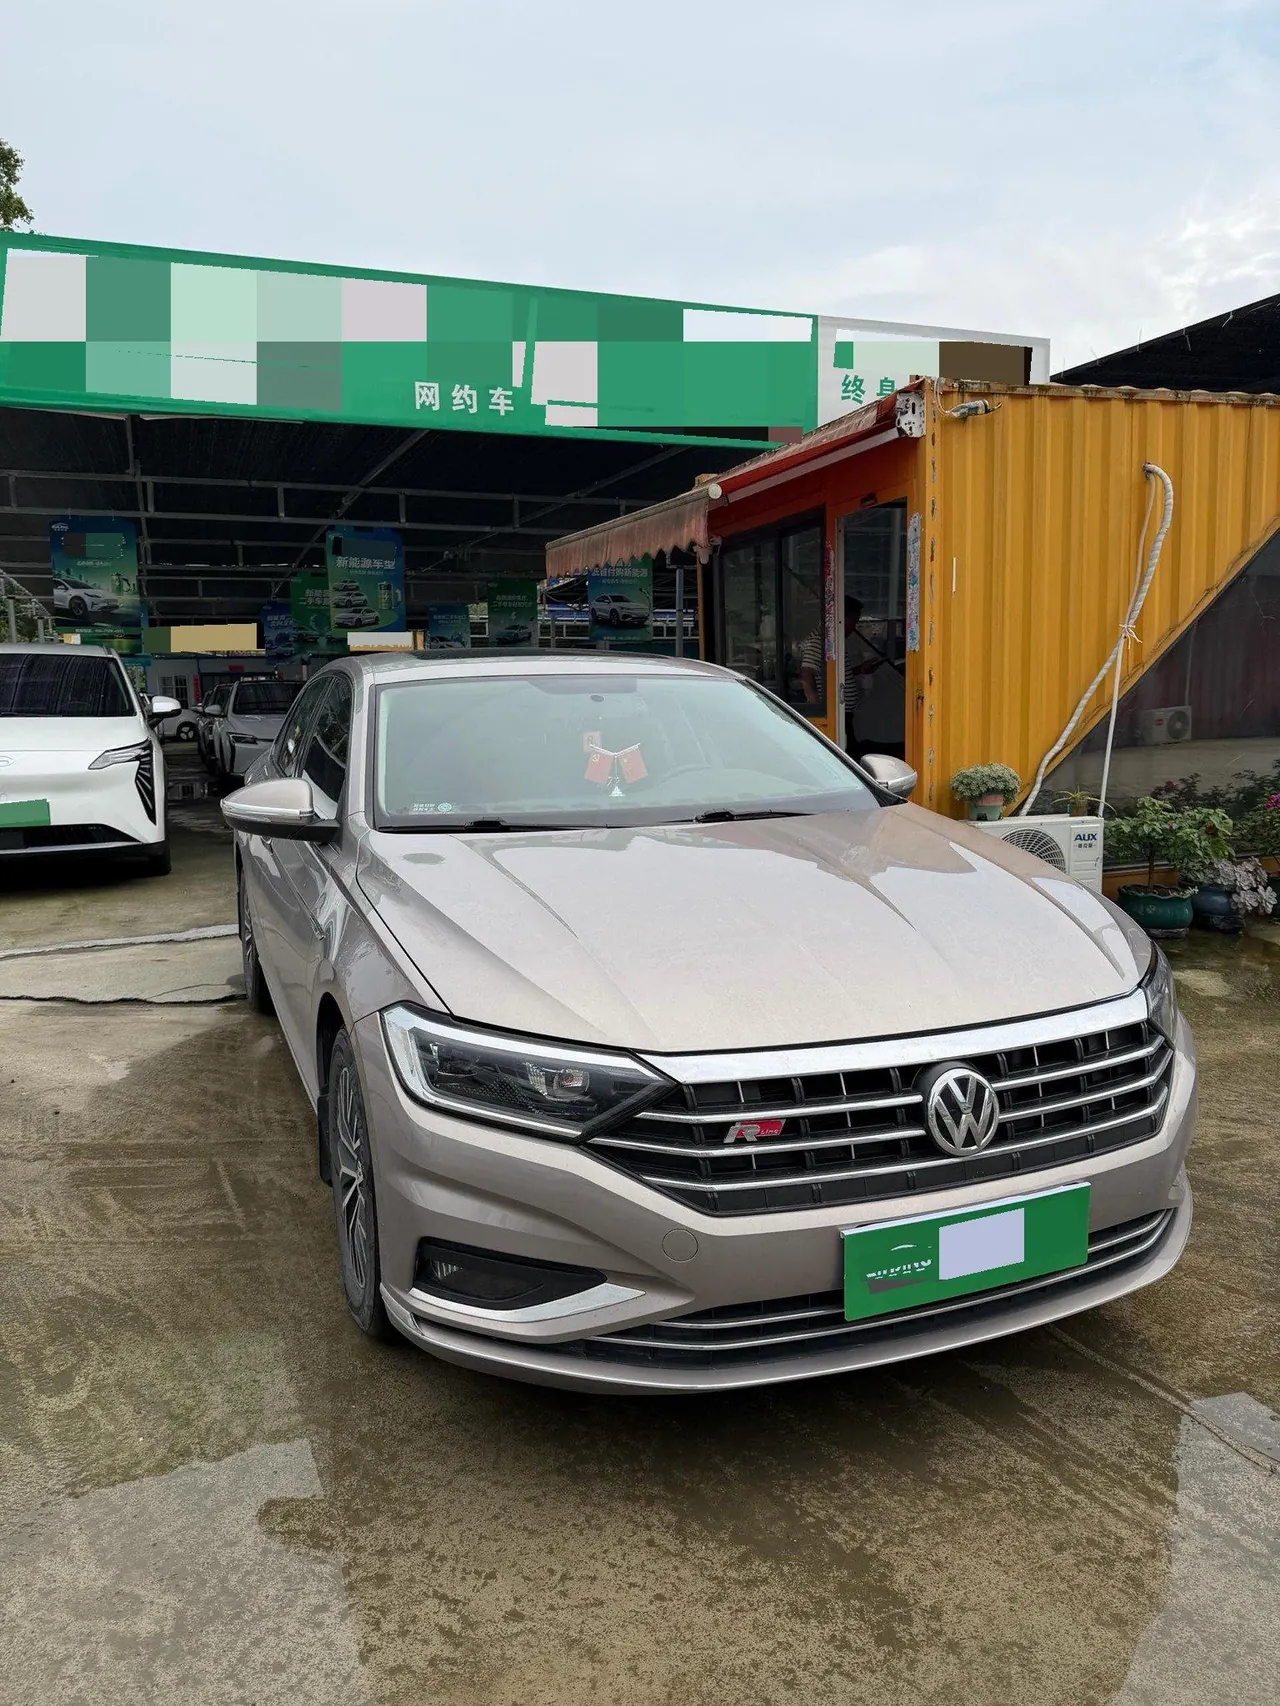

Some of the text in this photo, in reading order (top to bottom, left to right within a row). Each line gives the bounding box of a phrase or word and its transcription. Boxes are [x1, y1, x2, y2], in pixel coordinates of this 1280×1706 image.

[413, 380, 515, 416] 网约车
[335, 555, 397, 570] 新能源车型
[1074, 833, 1098, 842] AUX
